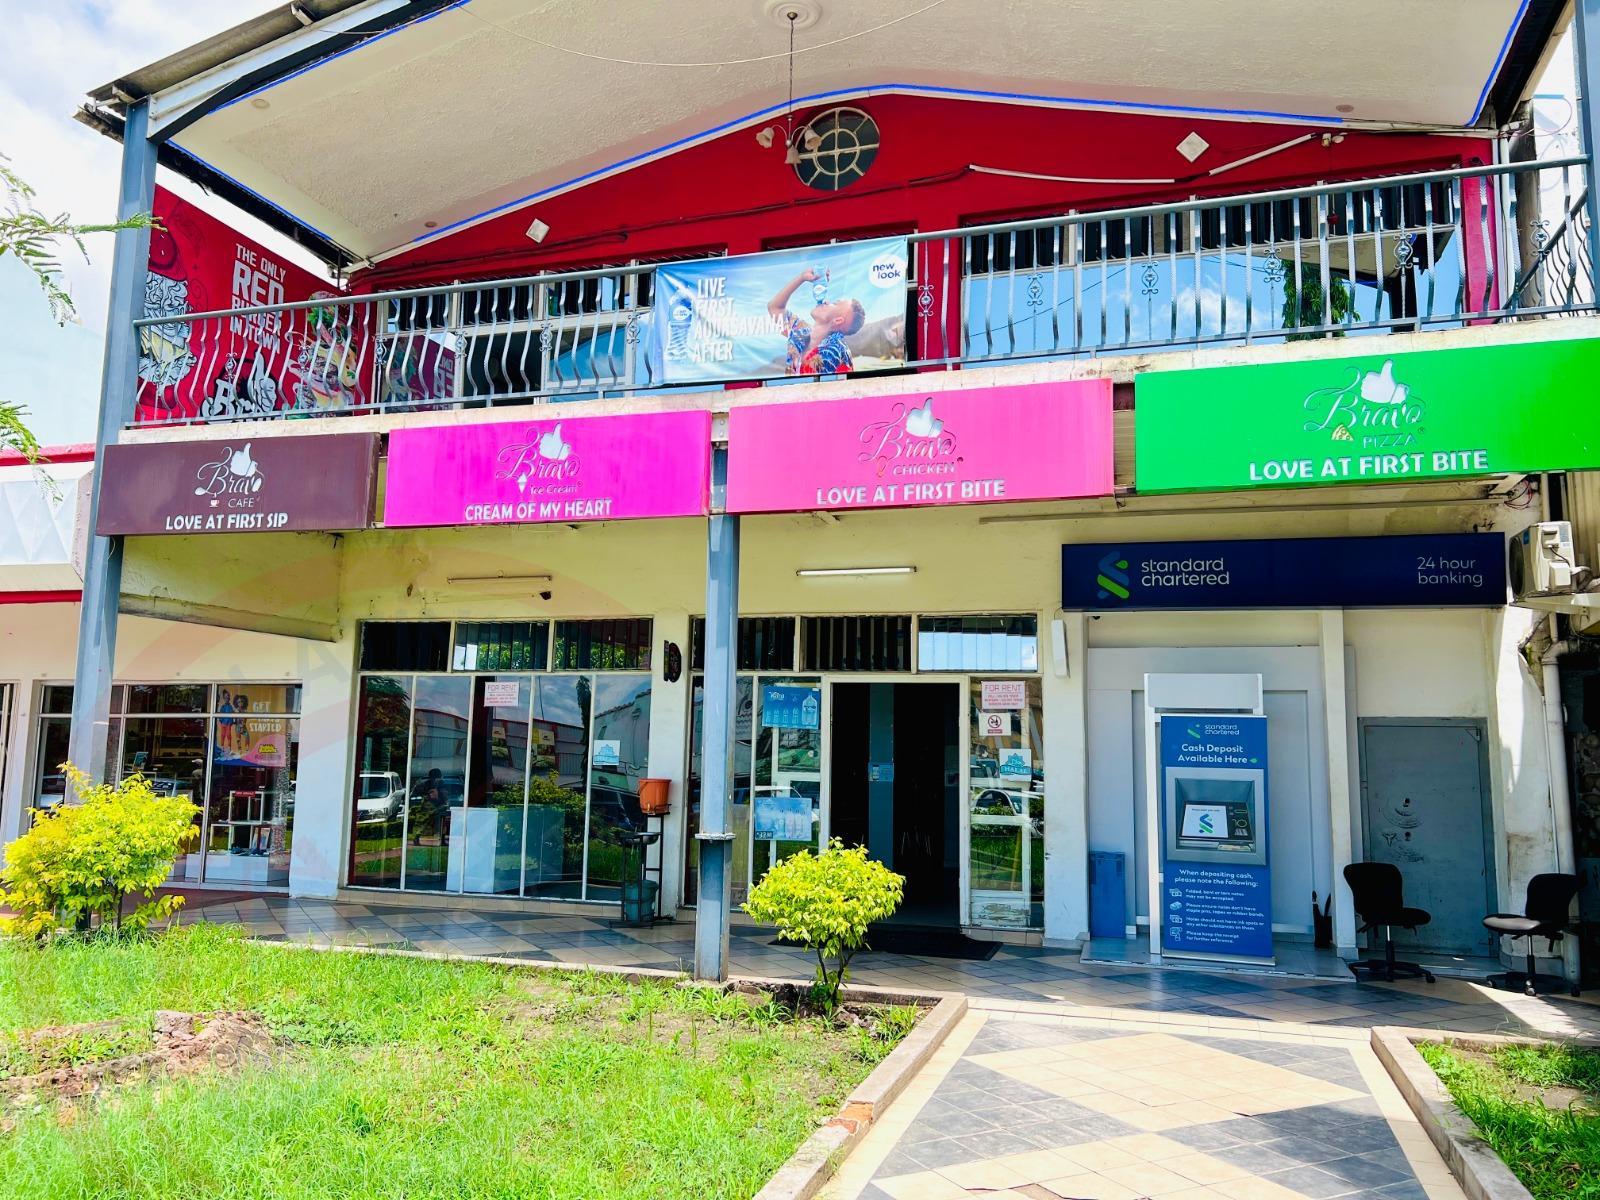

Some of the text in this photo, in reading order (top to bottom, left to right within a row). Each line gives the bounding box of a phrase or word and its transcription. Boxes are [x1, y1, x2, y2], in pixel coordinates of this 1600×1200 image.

[236, 243, 286, 283] THE ONLY
[872, 262, 895, 272] new
[878, 270, 900, 279] look
[232, 260, 284, 319] RED
[697, 276, 727, 298] LIVE
[693, 340, 734, 364] AFTER
[1363, 433, 1416, 448] PIZZA
[892, 462, 955, 476] CHICKEN
[1250, 450, 1488, 481] LOVE AT FIRST BITE
[546, 484, 577, 494] Cream
[816, 479, 1005, 505] LOVE AT FIRST BITE
[228, 498, 254, 508] CAFE
[465, 500, 612, 521] CREAM OF MY HEART
[166, 512, 288, 530] LOVE AT FIRST SIP
[1141, 558, 1224, 572] standard
[1417, 556, 1476, 570] 24 hour
[1141, 571, 1230, 587] chartered
[1418, 571, 1483, 588] banking
[984, 684, 1021, 692] FOR RENT
[253, 702, 272, 713] GET
[1182, 744, 1244, 754] Cash Deposit
[1178, 754, 1248, 764] Available Here
[1200, 870, 1235, 879] depositing
[1236, 872, 1254, 880] cash,
[1226, 879, 1259, 888] following:
